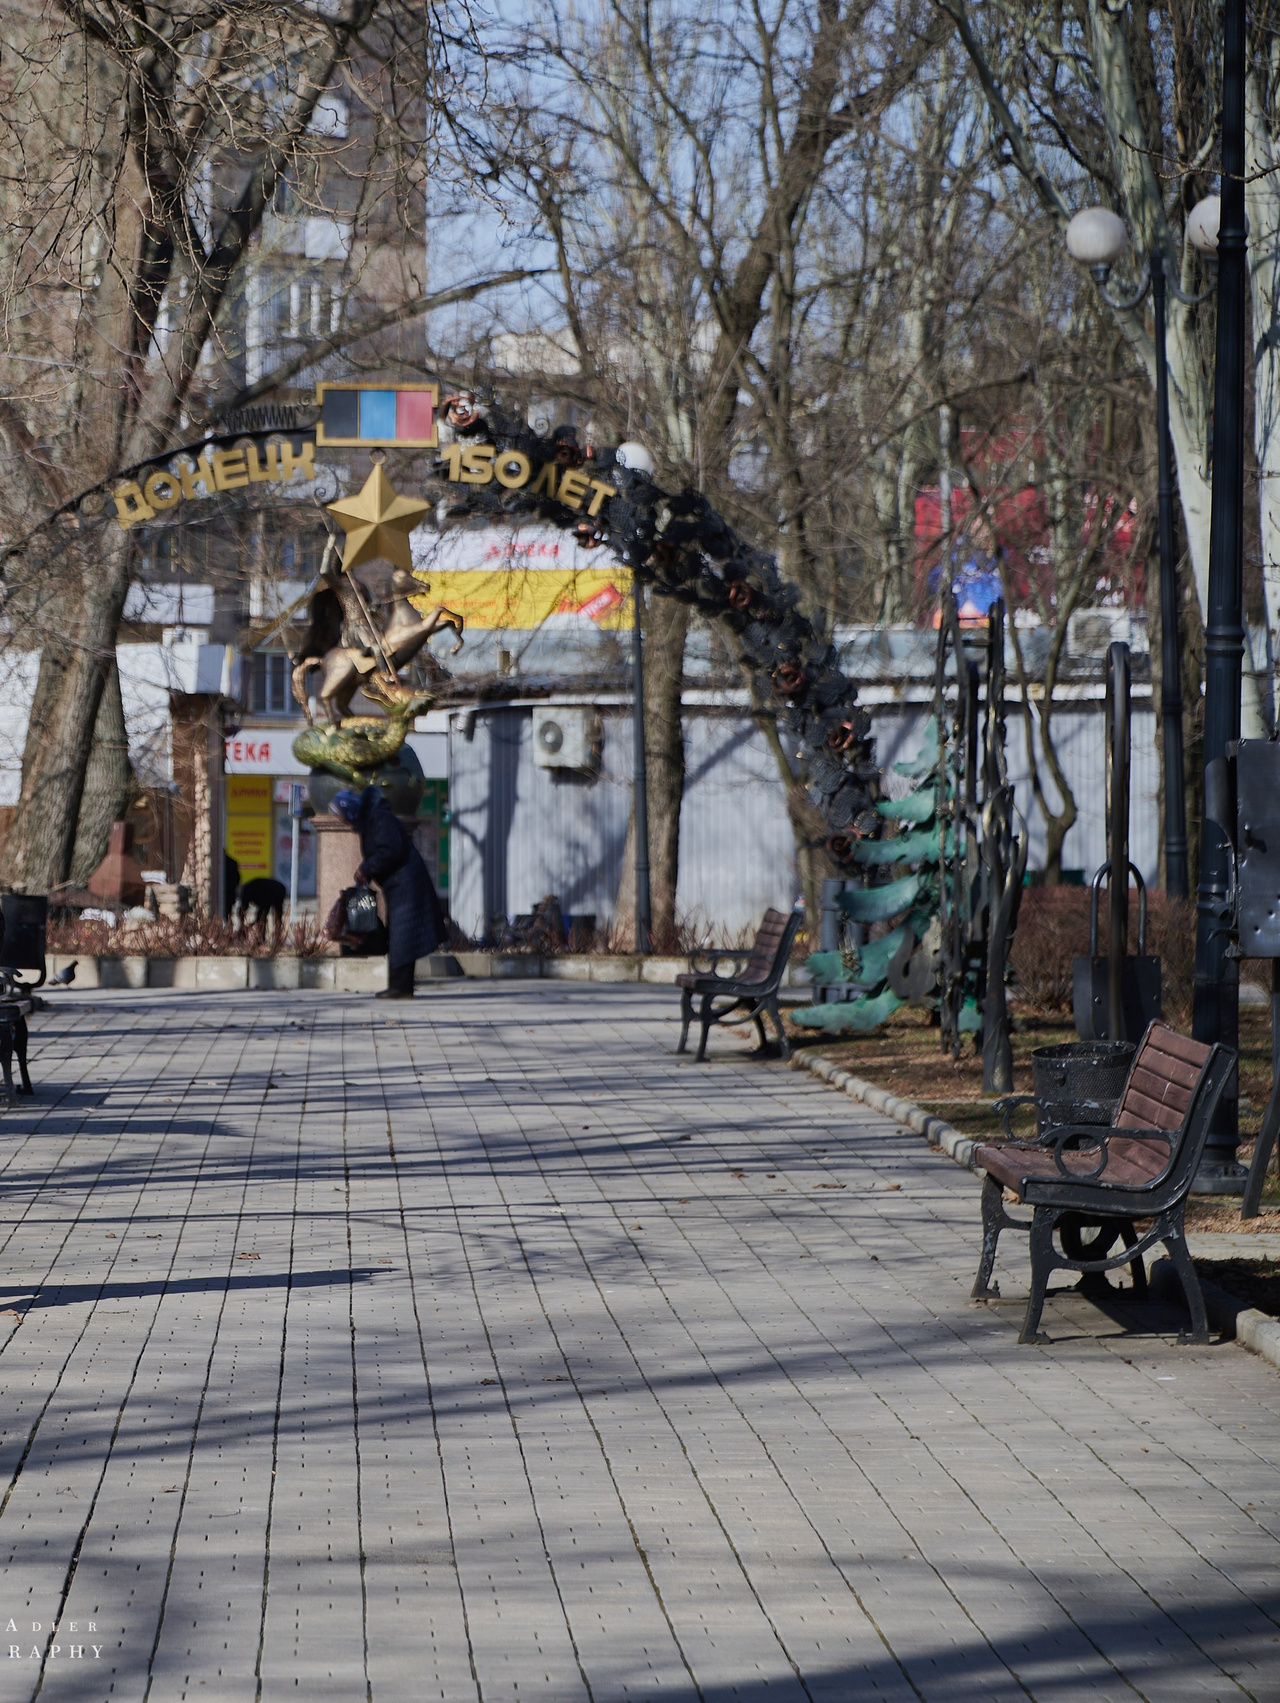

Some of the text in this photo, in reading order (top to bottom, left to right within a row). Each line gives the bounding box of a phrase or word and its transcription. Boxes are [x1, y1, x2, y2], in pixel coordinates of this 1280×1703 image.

[113, 441, 618, 531] ДОНЕЦК 150 ЛЕТ
